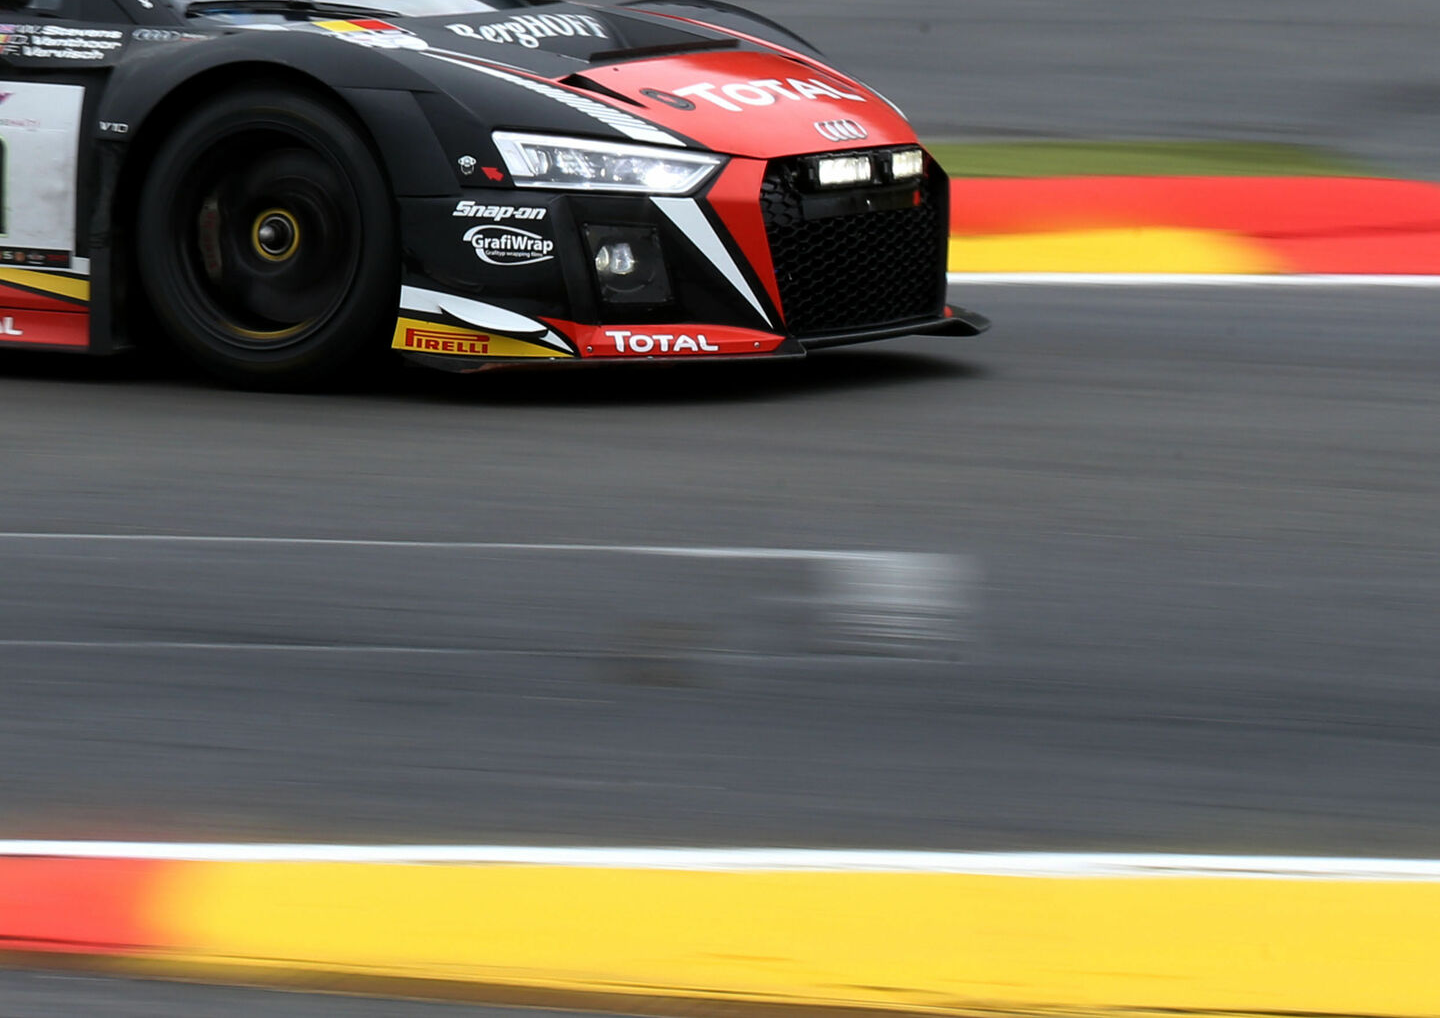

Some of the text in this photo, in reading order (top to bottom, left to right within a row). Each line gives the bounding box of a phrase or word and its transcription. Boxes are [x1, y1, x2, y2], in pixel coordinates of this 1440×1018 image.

[445, 12, 608, 49] BergHOFF
[672, 77, 867, 112] TOTAL
[98, 120, 129, 133] V10
[452, 200, 547, 222] Snap-on
[471, 234, 554, 255] GrafiWrap
[405, 327, 490, 354] PIRELLI
[605, 330, 719, 353] TOTAL
